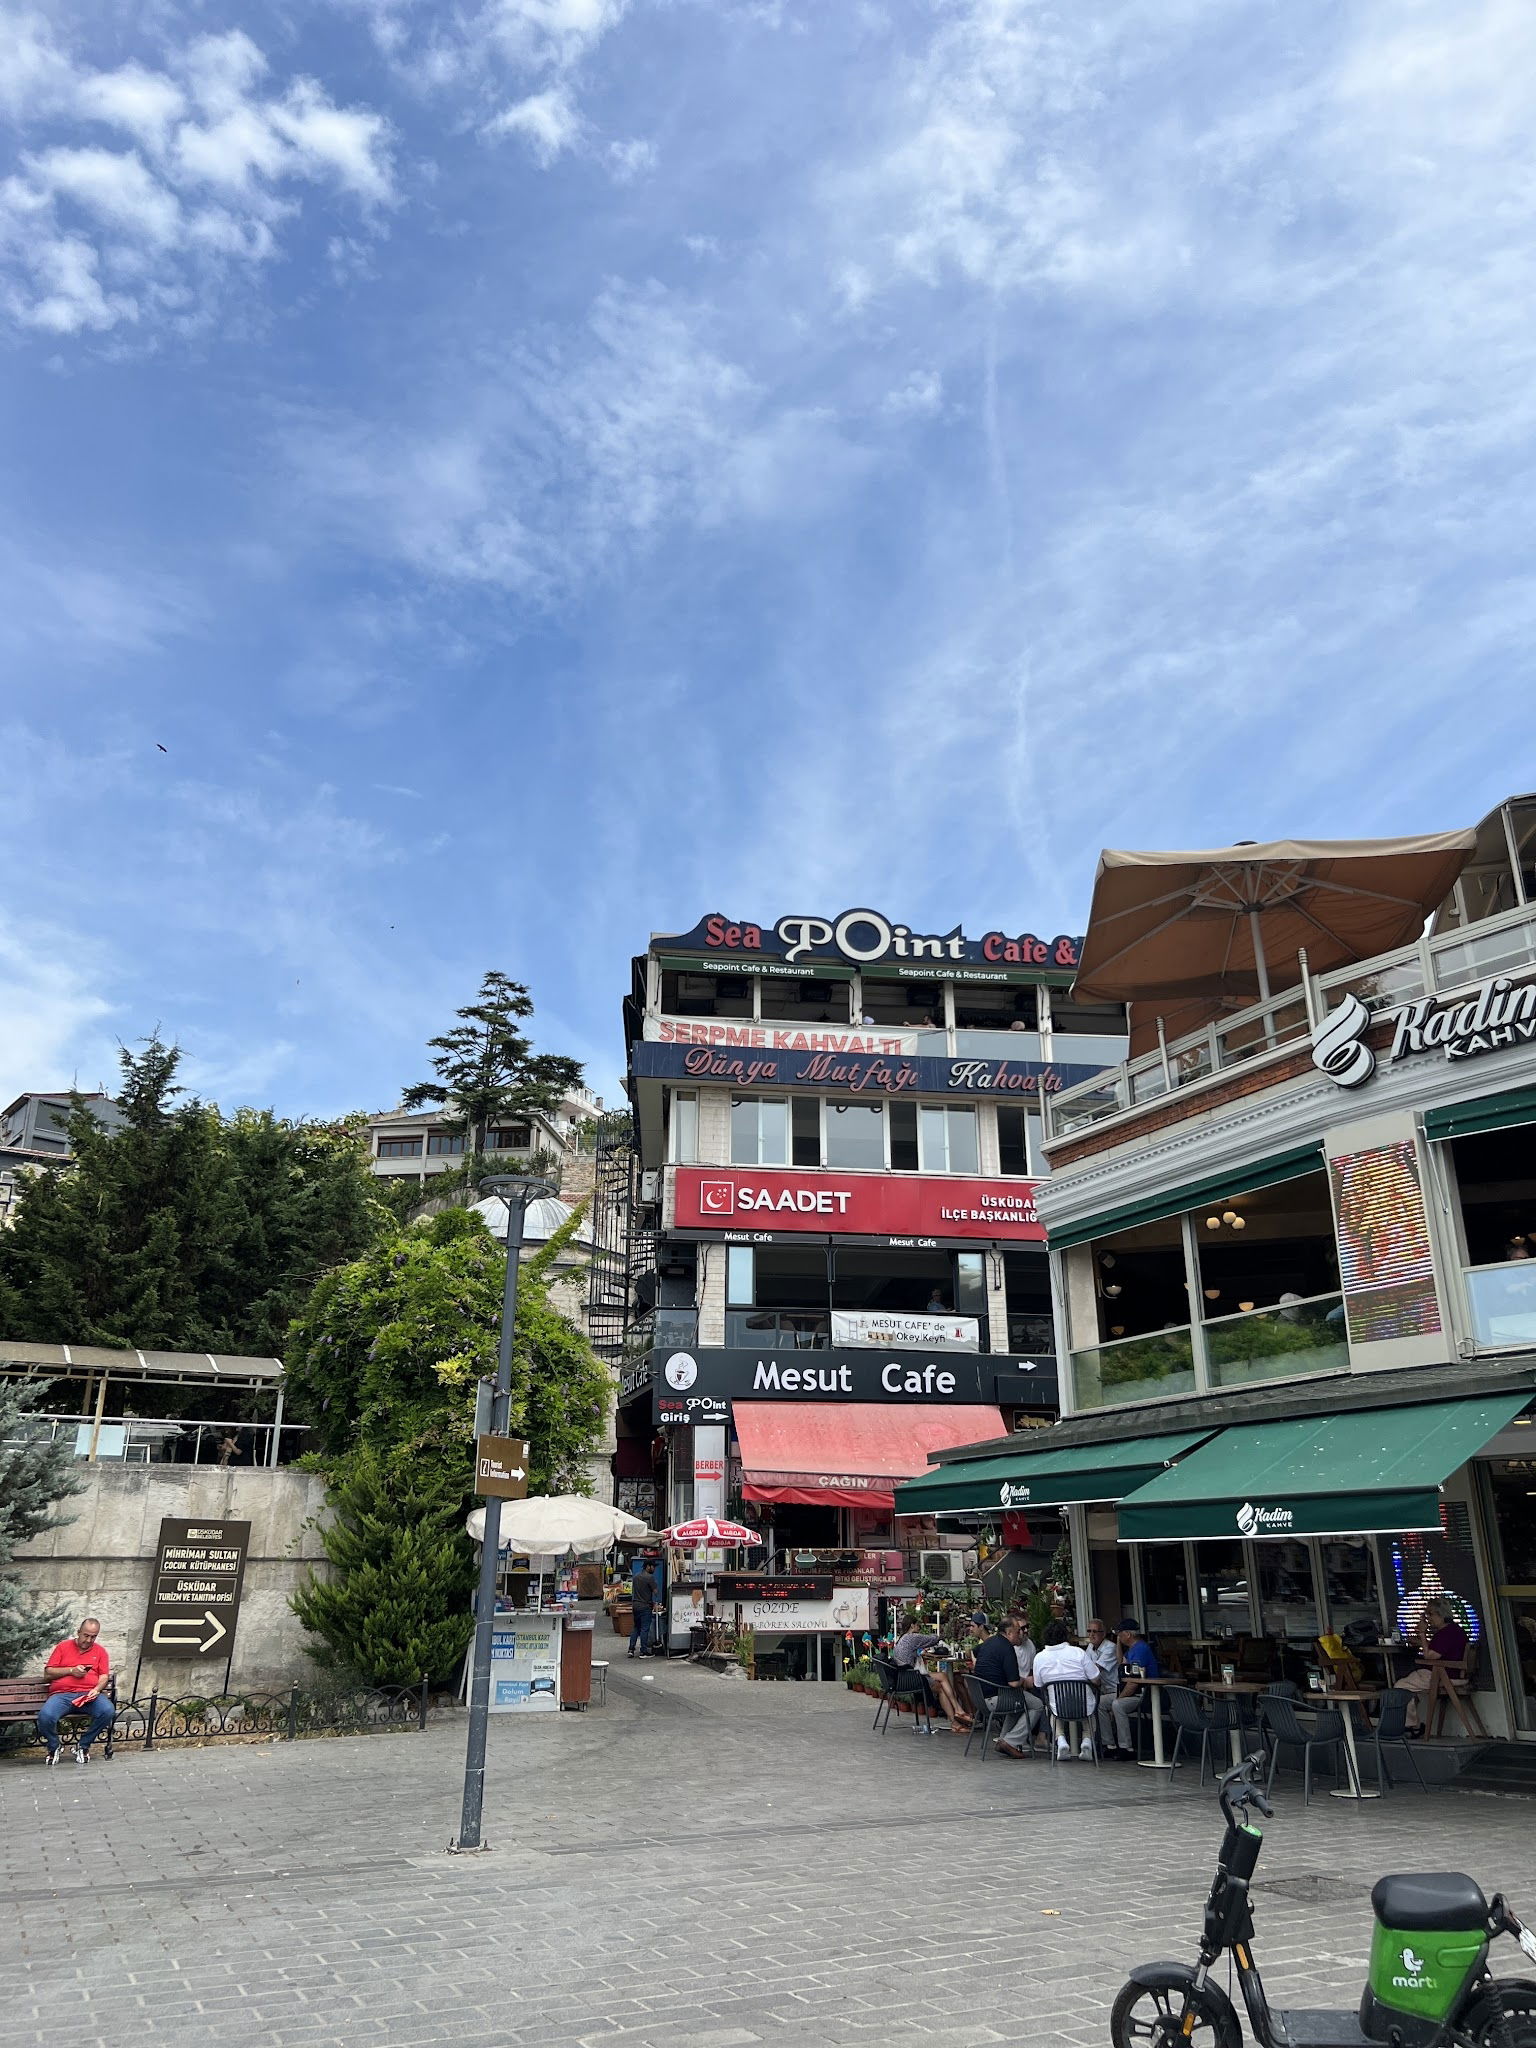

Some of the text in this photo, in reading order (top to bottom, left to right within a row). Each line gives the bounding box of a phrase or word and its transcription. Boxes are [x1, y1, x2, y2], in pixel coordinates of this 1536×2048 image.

[705, 916, 762, 949] Sea
[983, 934, 1048, 964] Cafe
[1055, 938, 1078, 965] &
[702, 962, 815, 976] Seapoint Cafe & Restaurant
[898, 968, 1008, 981] Seapoint Cafe & Restaurant
[658, 1021, 902, 1056] SERPME KAHVALTI
[684, 1046, 778, 1085] Dünya
[737, 1188, 852, 1214] SAADET
[941, 1206, 1038, 1223] İLÇE BAŞKANLIĞ
[724, 1232, 773, 1242] Mesut Cafe
[889, 1237, 937, 1247] Mesut Cafe
[871, 1319, 902, 1329] MESUT
[934, 1322, 945, 1331] de
[896, 1332, 946, 1344] Okey Keyfi
[752, 1360, 956, 1394] Mesut Cafe
[658, 1399, 683, 1410] Sea
[660, 1412, 691, 1423] Giriş
[695, 1460, 724, 1470] BERBER
[818, 1475, 868, 1488] ÇAĞIN
[1254, 1507, 1293, 1522] Kadim
[166, 1547, 238, 1560] MİHRİMAH SULTAN
[164, 1560, 236, 1572] ÇOCUK KÜTÜPHANESİ
[177, 1580, 216, 1592] ÜSKÜDAR
[159, 1592, 182, 1601] TURİZM
[183, 1593, 190, 1601] VE
[191, 1593, 216, 1601] TANITIM
[753, 1600, 800, 1618] GÖZDE
